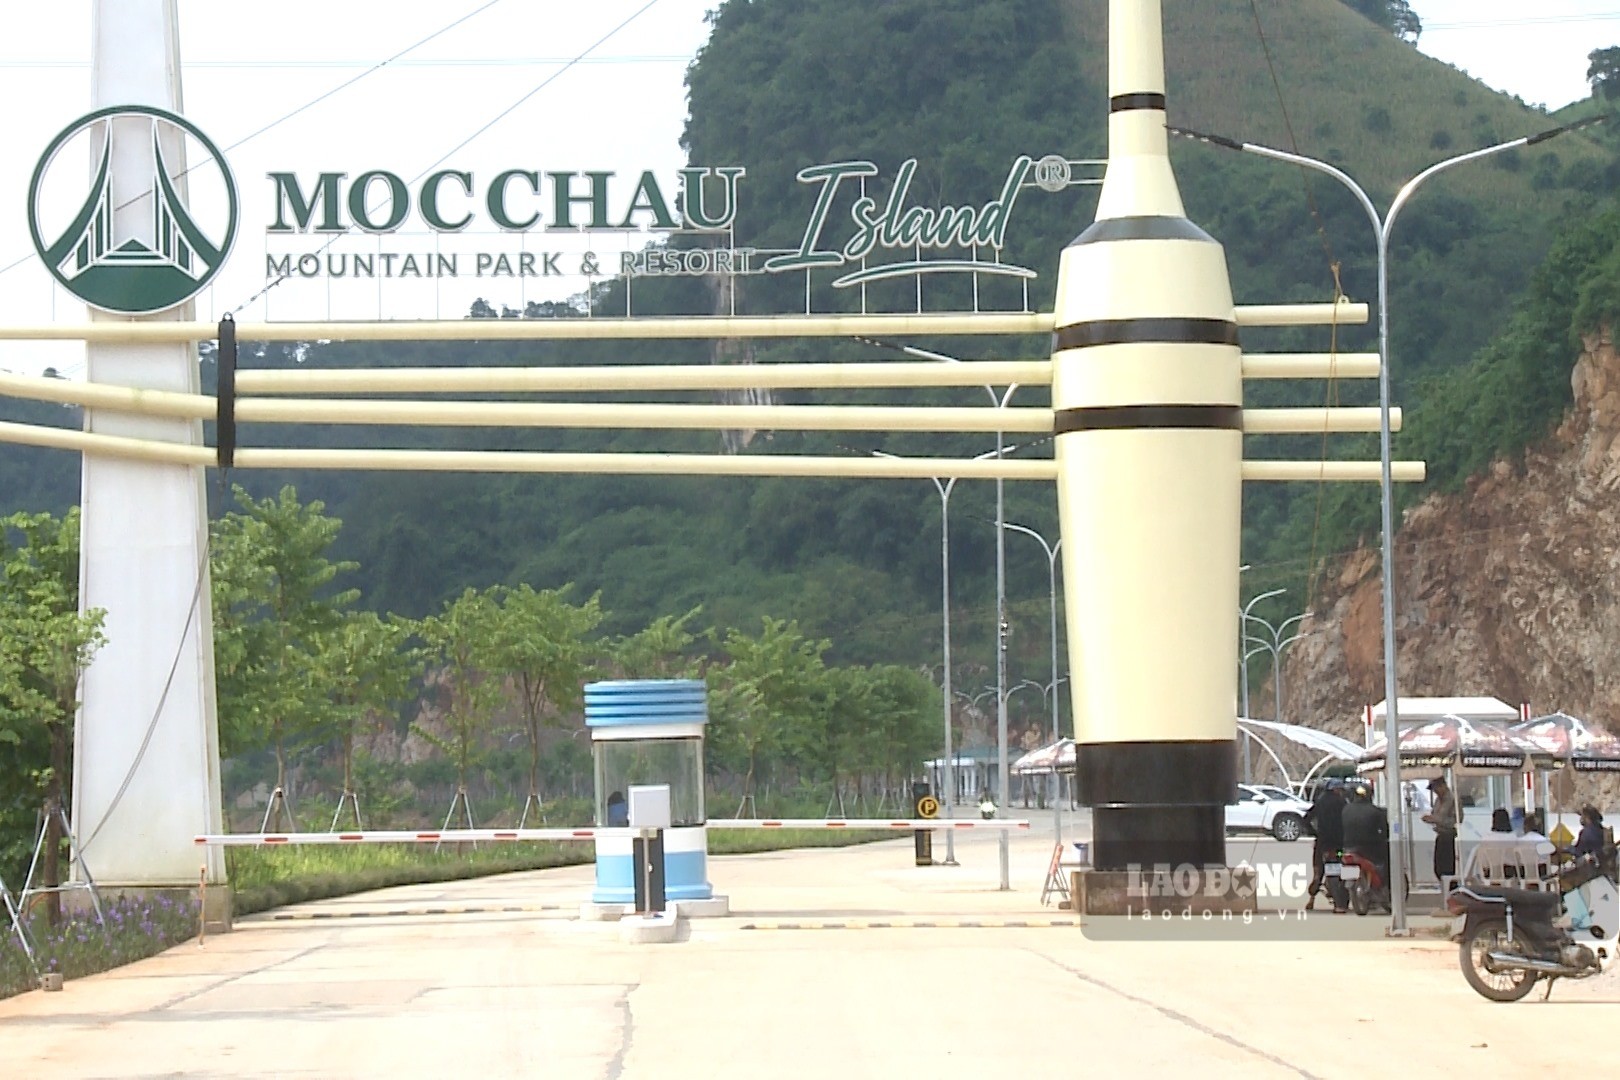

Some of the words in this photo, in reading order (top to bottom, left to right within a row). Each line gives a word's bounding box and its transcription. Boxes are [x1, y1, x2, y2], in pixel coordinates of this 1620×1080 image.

[766, 155, 1032, 272] Island
[266, 253, 457, 278] MOUNTAIN
[475, 251, 563, 278] PARK
[580, 251, 601, 277] &
[620, 249, 756, 277] RESORT
